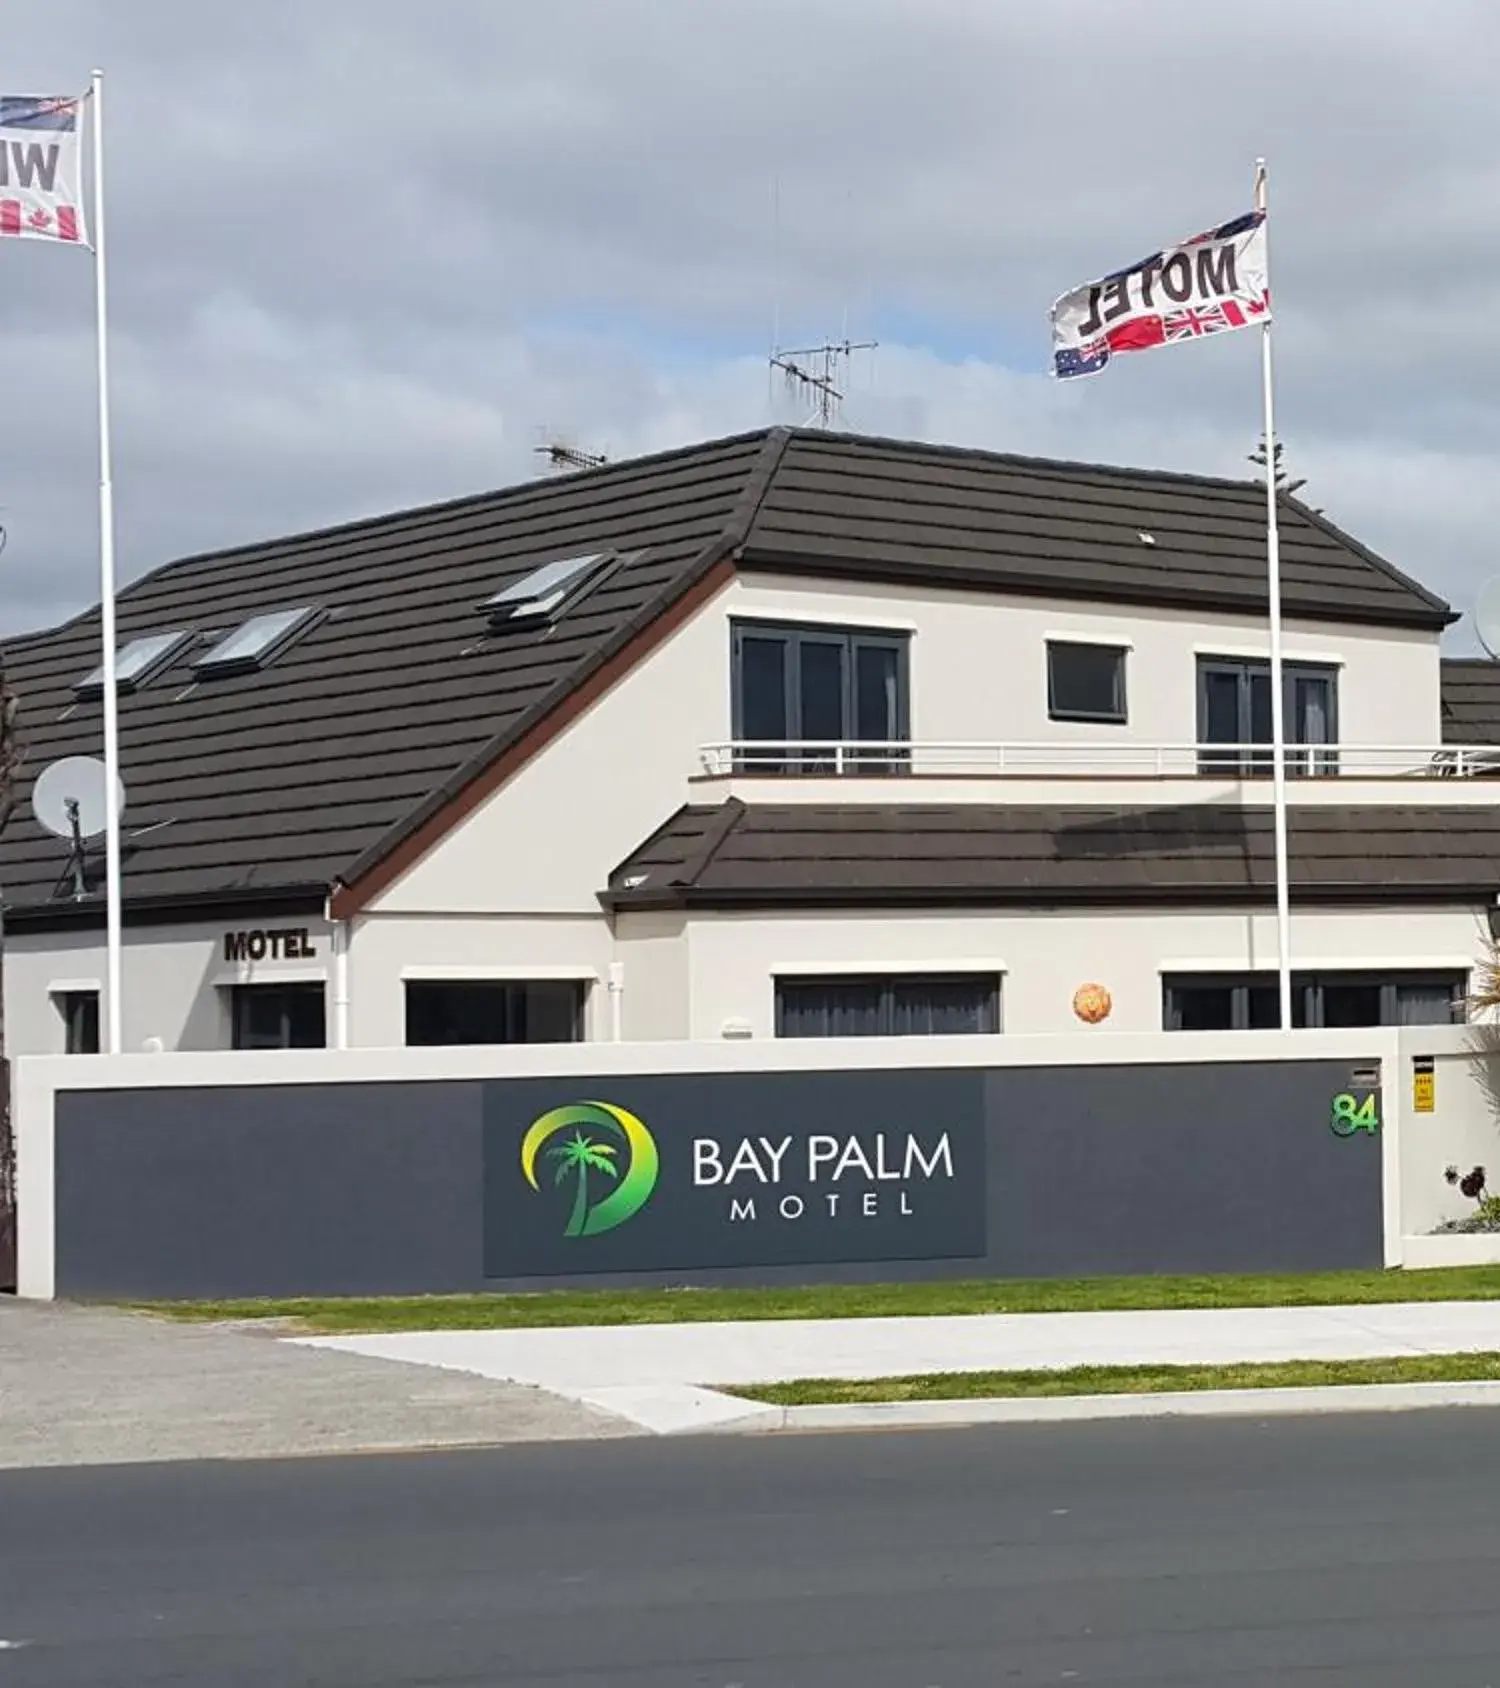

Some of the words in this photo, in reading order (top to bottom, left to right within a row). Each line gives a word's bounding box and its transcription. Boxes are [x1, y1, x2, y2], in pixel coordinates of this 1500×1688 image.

[224, 928, 316, 961] MOTEL
[1330, 1092, 1379, 1138] 84
[693, 1135, 793, 1186] BAY
[808, 1132, 954, 1183] PALM
[729, 1191, 913, 1221] MOTEL
